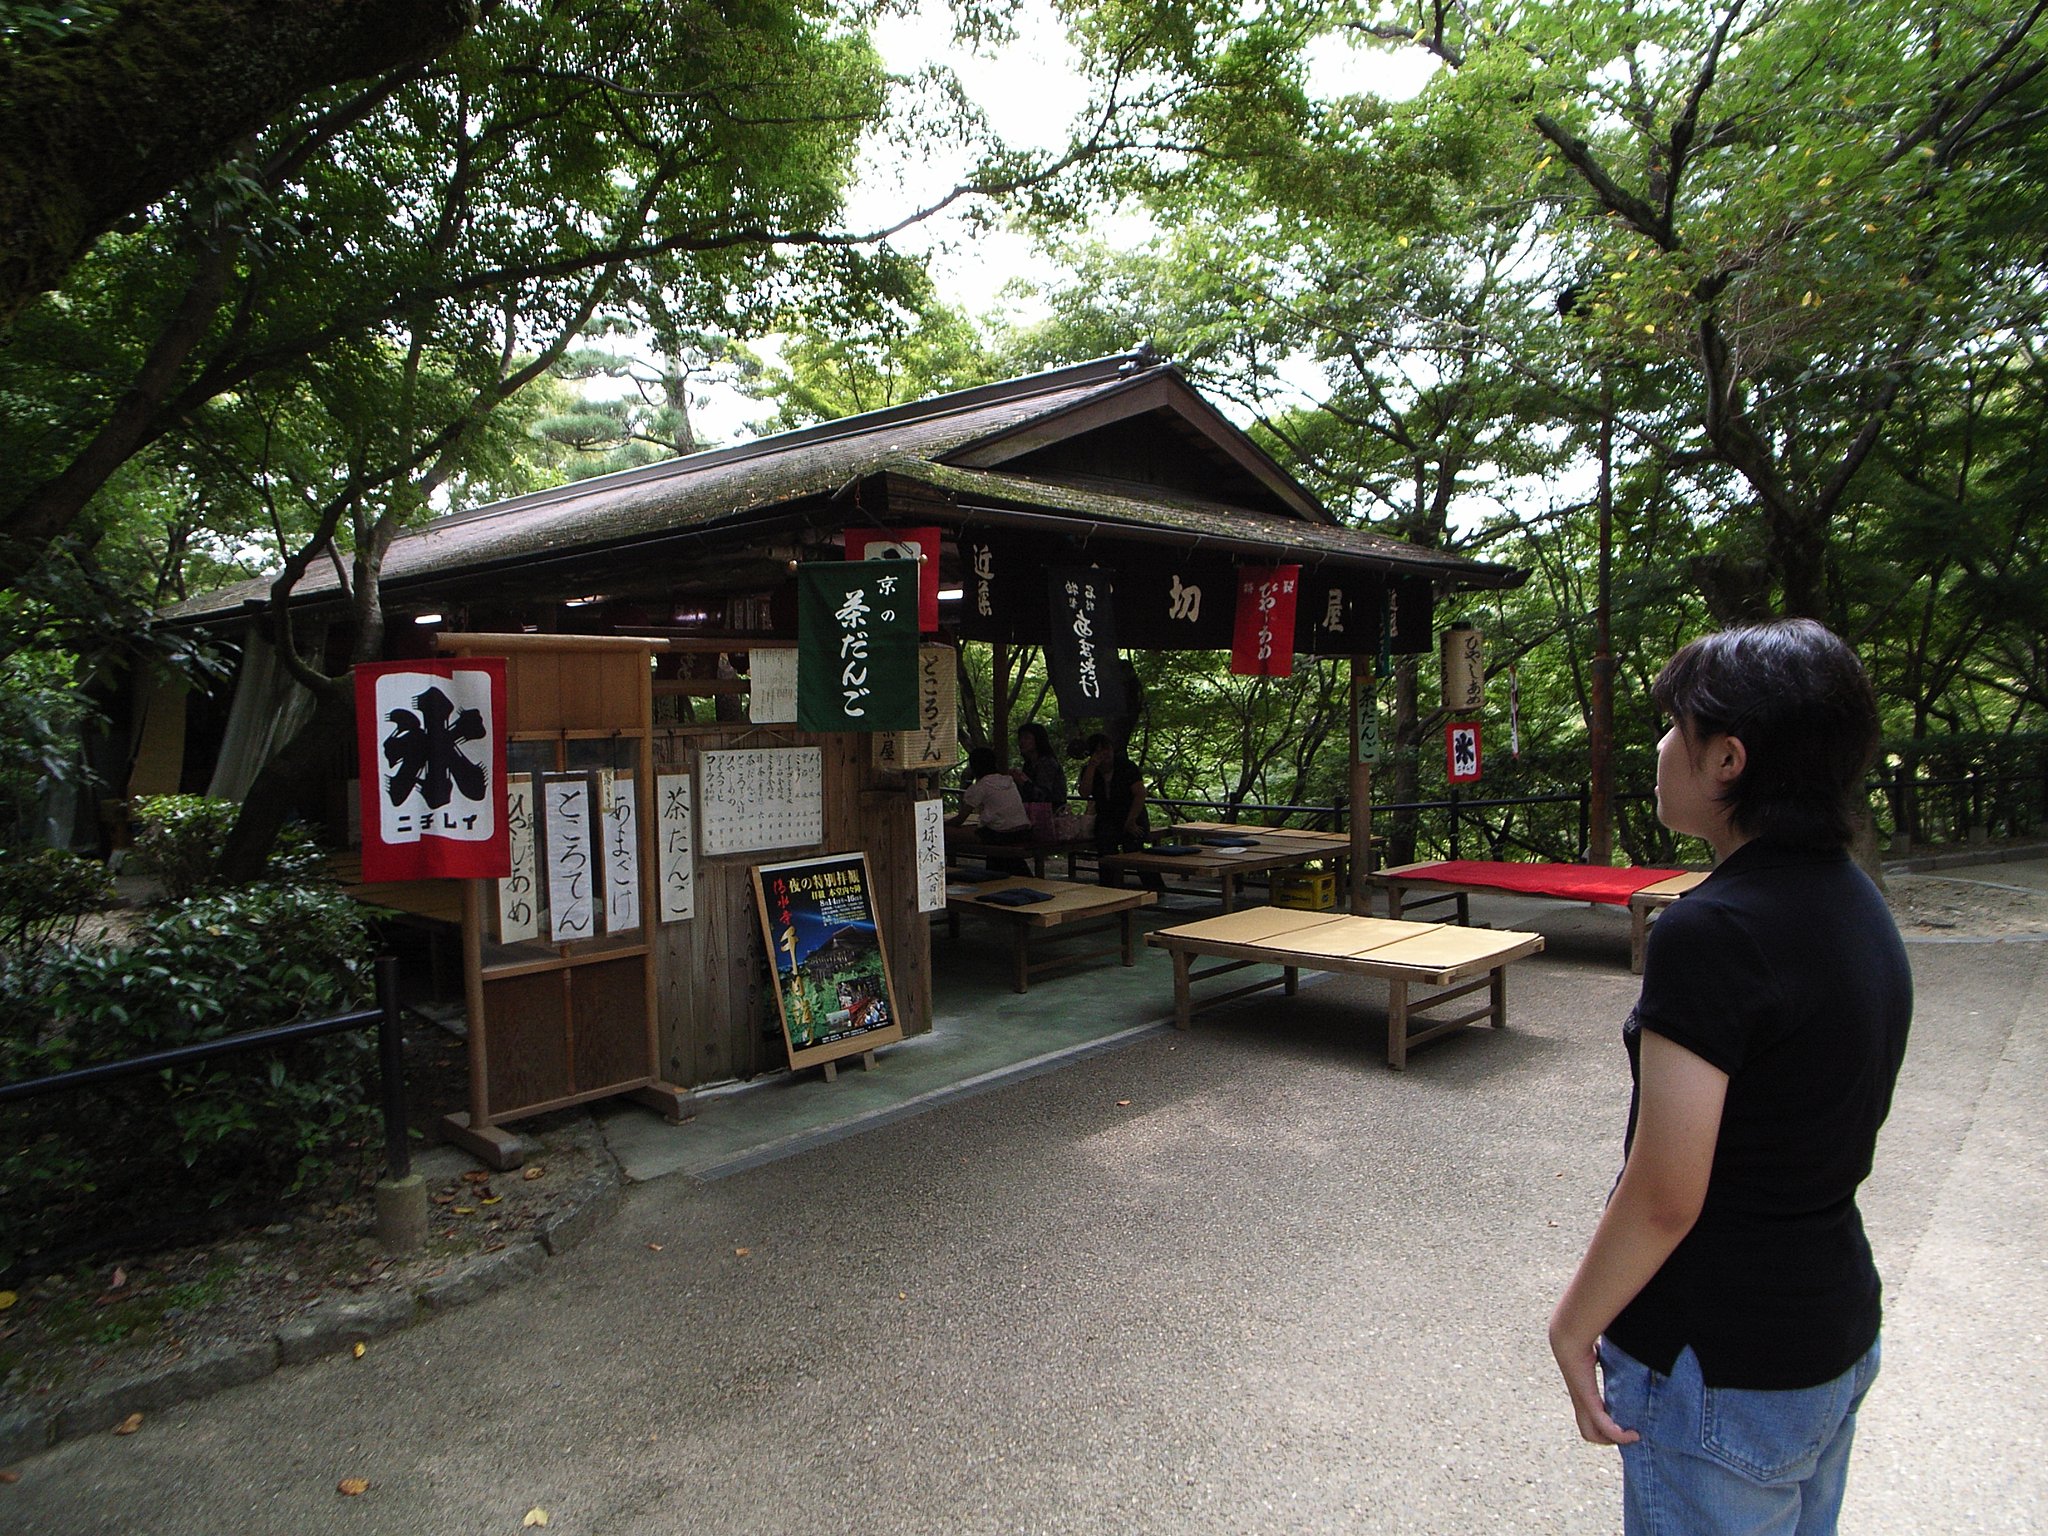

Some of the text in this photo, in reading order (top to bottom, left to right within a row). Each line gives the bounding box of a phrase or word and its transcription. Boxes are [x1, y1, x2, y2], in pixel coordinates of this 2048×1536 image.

[876, 575, 898, 623] 京の
[1257, 582, 1279, 660] ひやしあめ
[835, 588, 871, 717] 茶だんご
[1464, 635, 1481, 704] ひやしあめ
[384, 686, 489, 810] 氷
[922, 655, 941, 761] ところてん
[1455, 732, 1474, 765] 氷
[397, 813, 478, 832] ニチレイ
[506, 793, 531, 929] ひやしあめ
[558, 790, 590, 933] ところてん
[663, 786, 690, 914] 茶だんご
